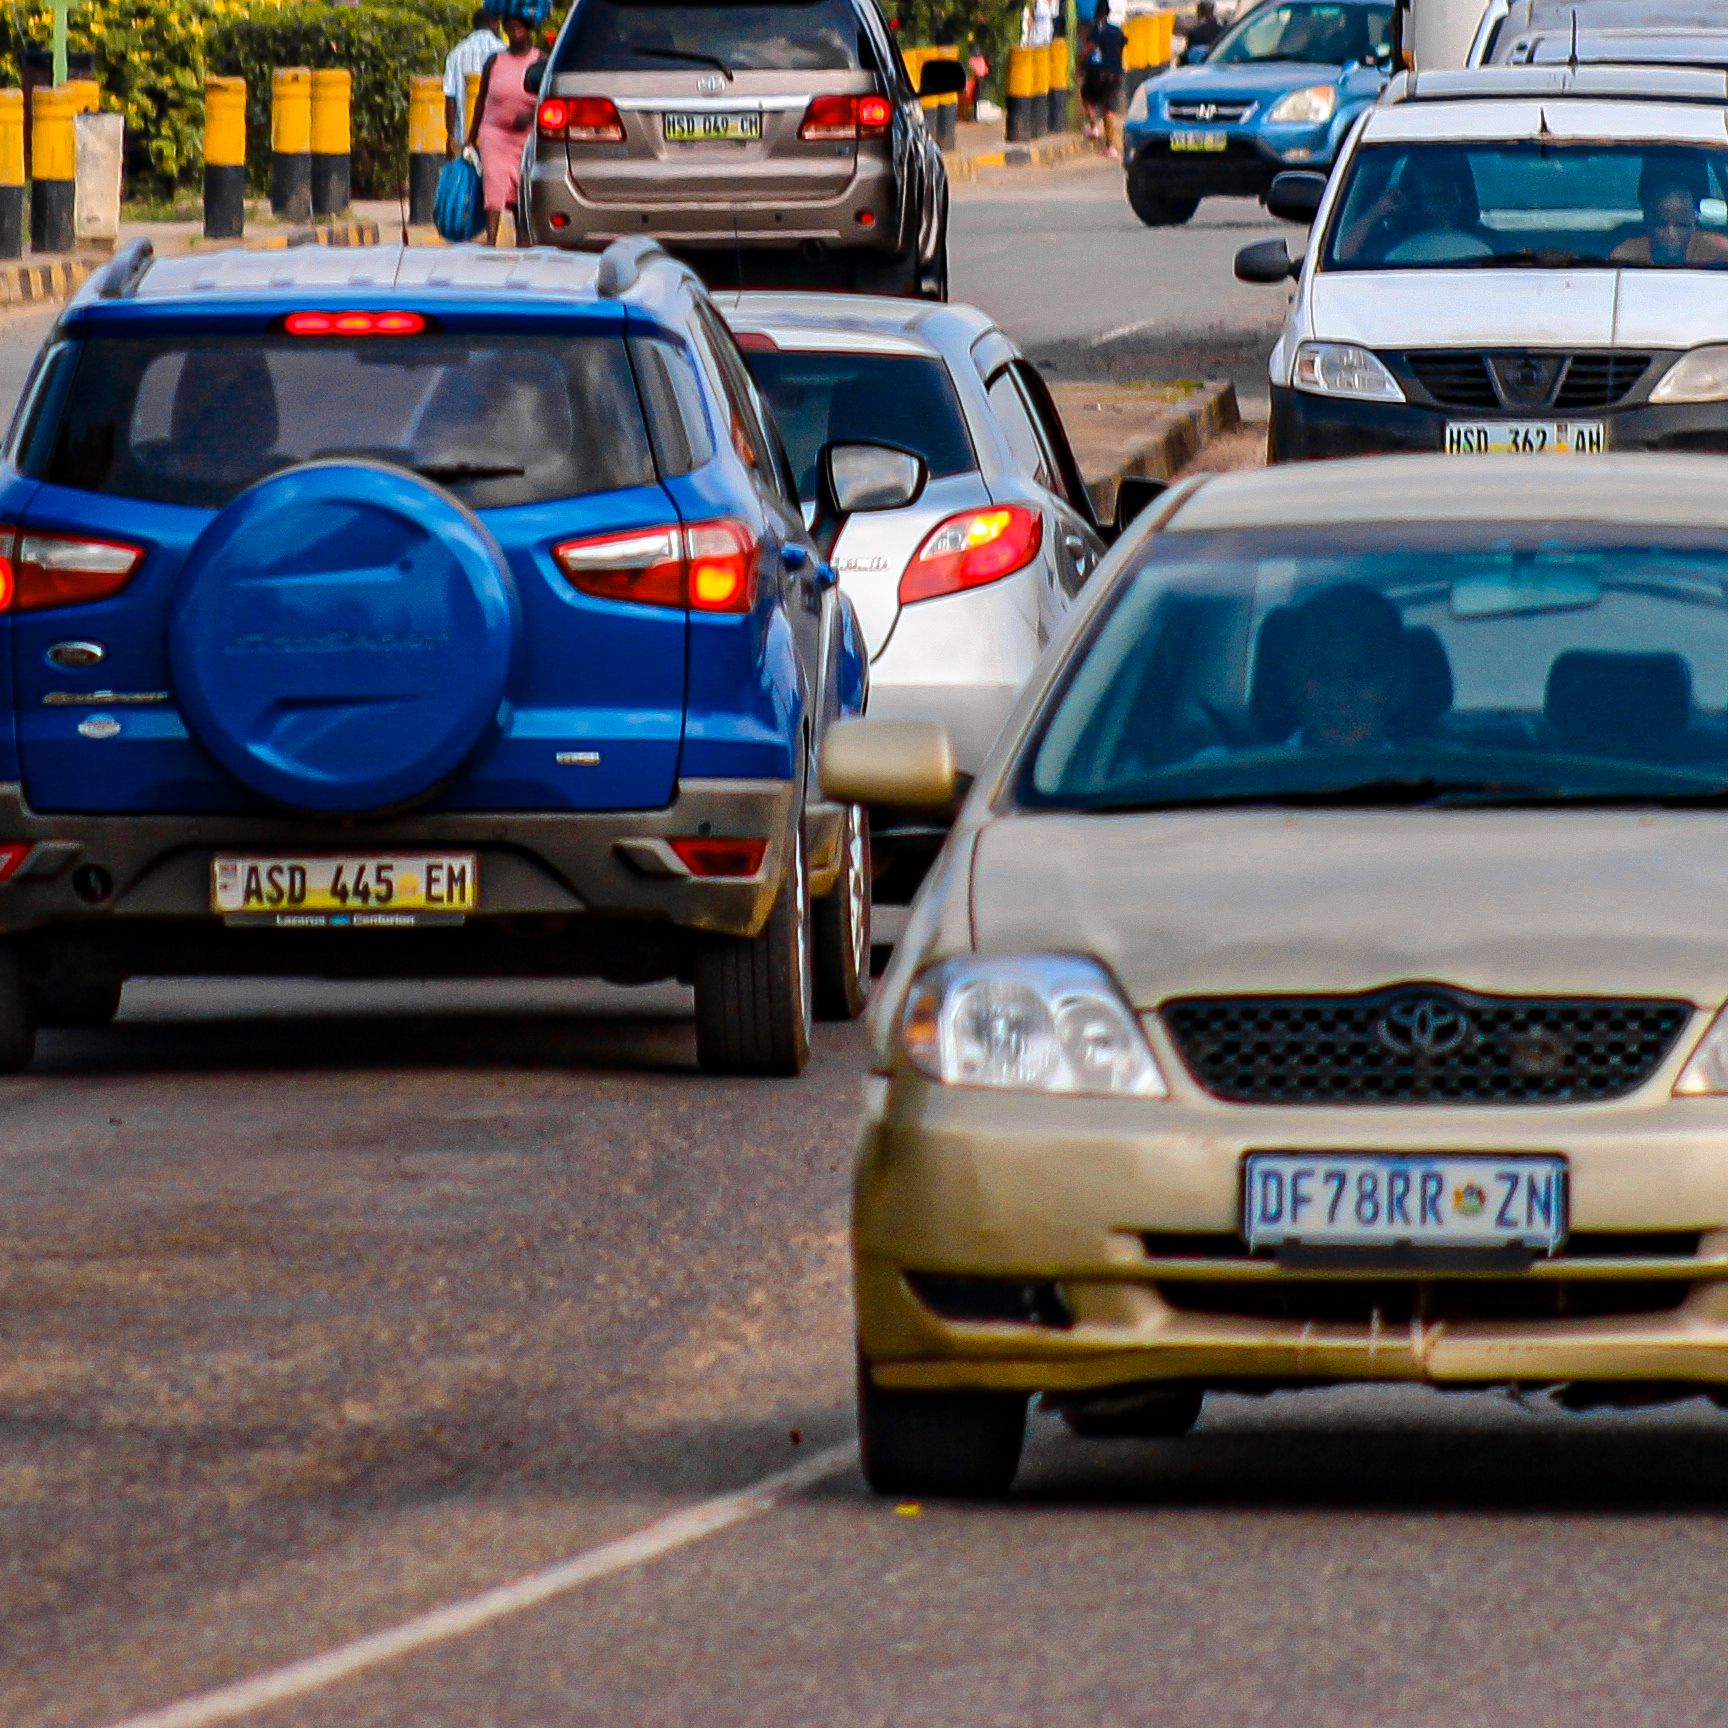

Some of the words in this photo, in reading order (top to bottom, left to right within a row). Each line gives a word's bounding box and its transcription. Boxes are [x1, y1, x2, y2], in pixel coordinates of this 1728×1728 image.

[1448, 424, 1489, 454] HSD
[1508, 424, 1548, 454] 362
[1575, 424, 1603, 454] AH
[244, 864, 307, 905] ASD
[329, 863, 394, 905] 445
[425, 862, 467, 903] EM
[1259, 1170, 1445, 1226] DF78RR
[1494, 1171, 1553, 1228] ZN
